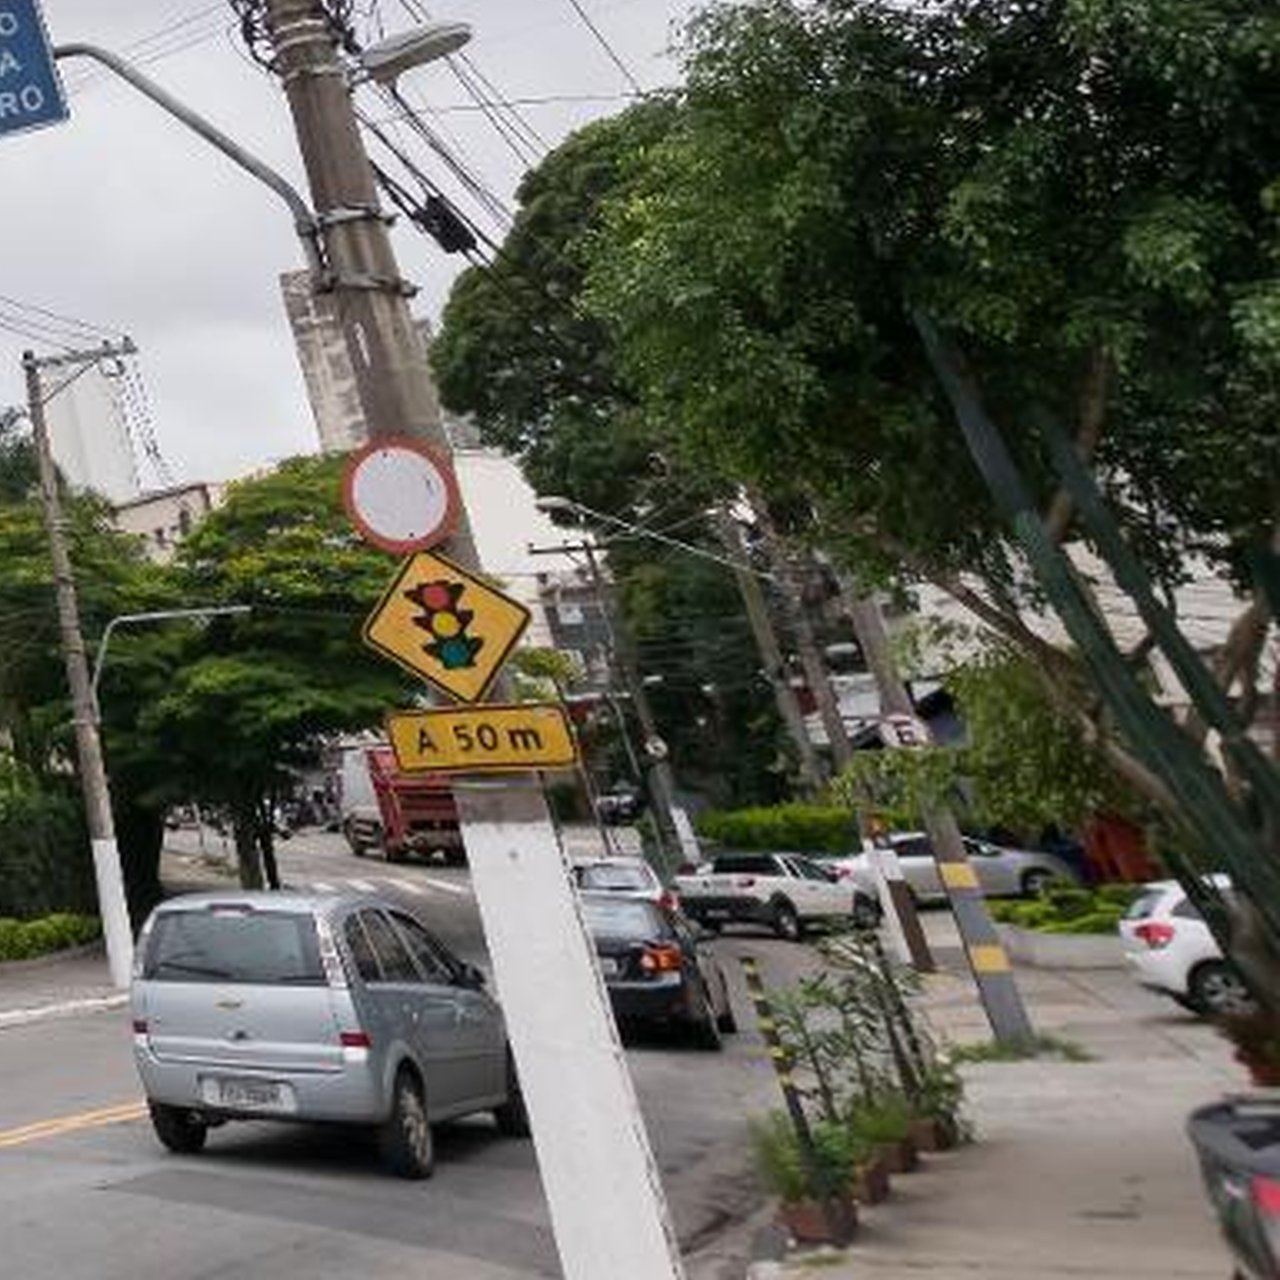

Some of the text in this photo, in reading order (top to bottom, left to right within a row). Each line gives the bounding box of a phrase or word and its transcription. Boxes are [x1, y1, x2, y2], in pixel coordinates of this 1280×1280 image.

[418, 724, 543, 755] A 50 m
